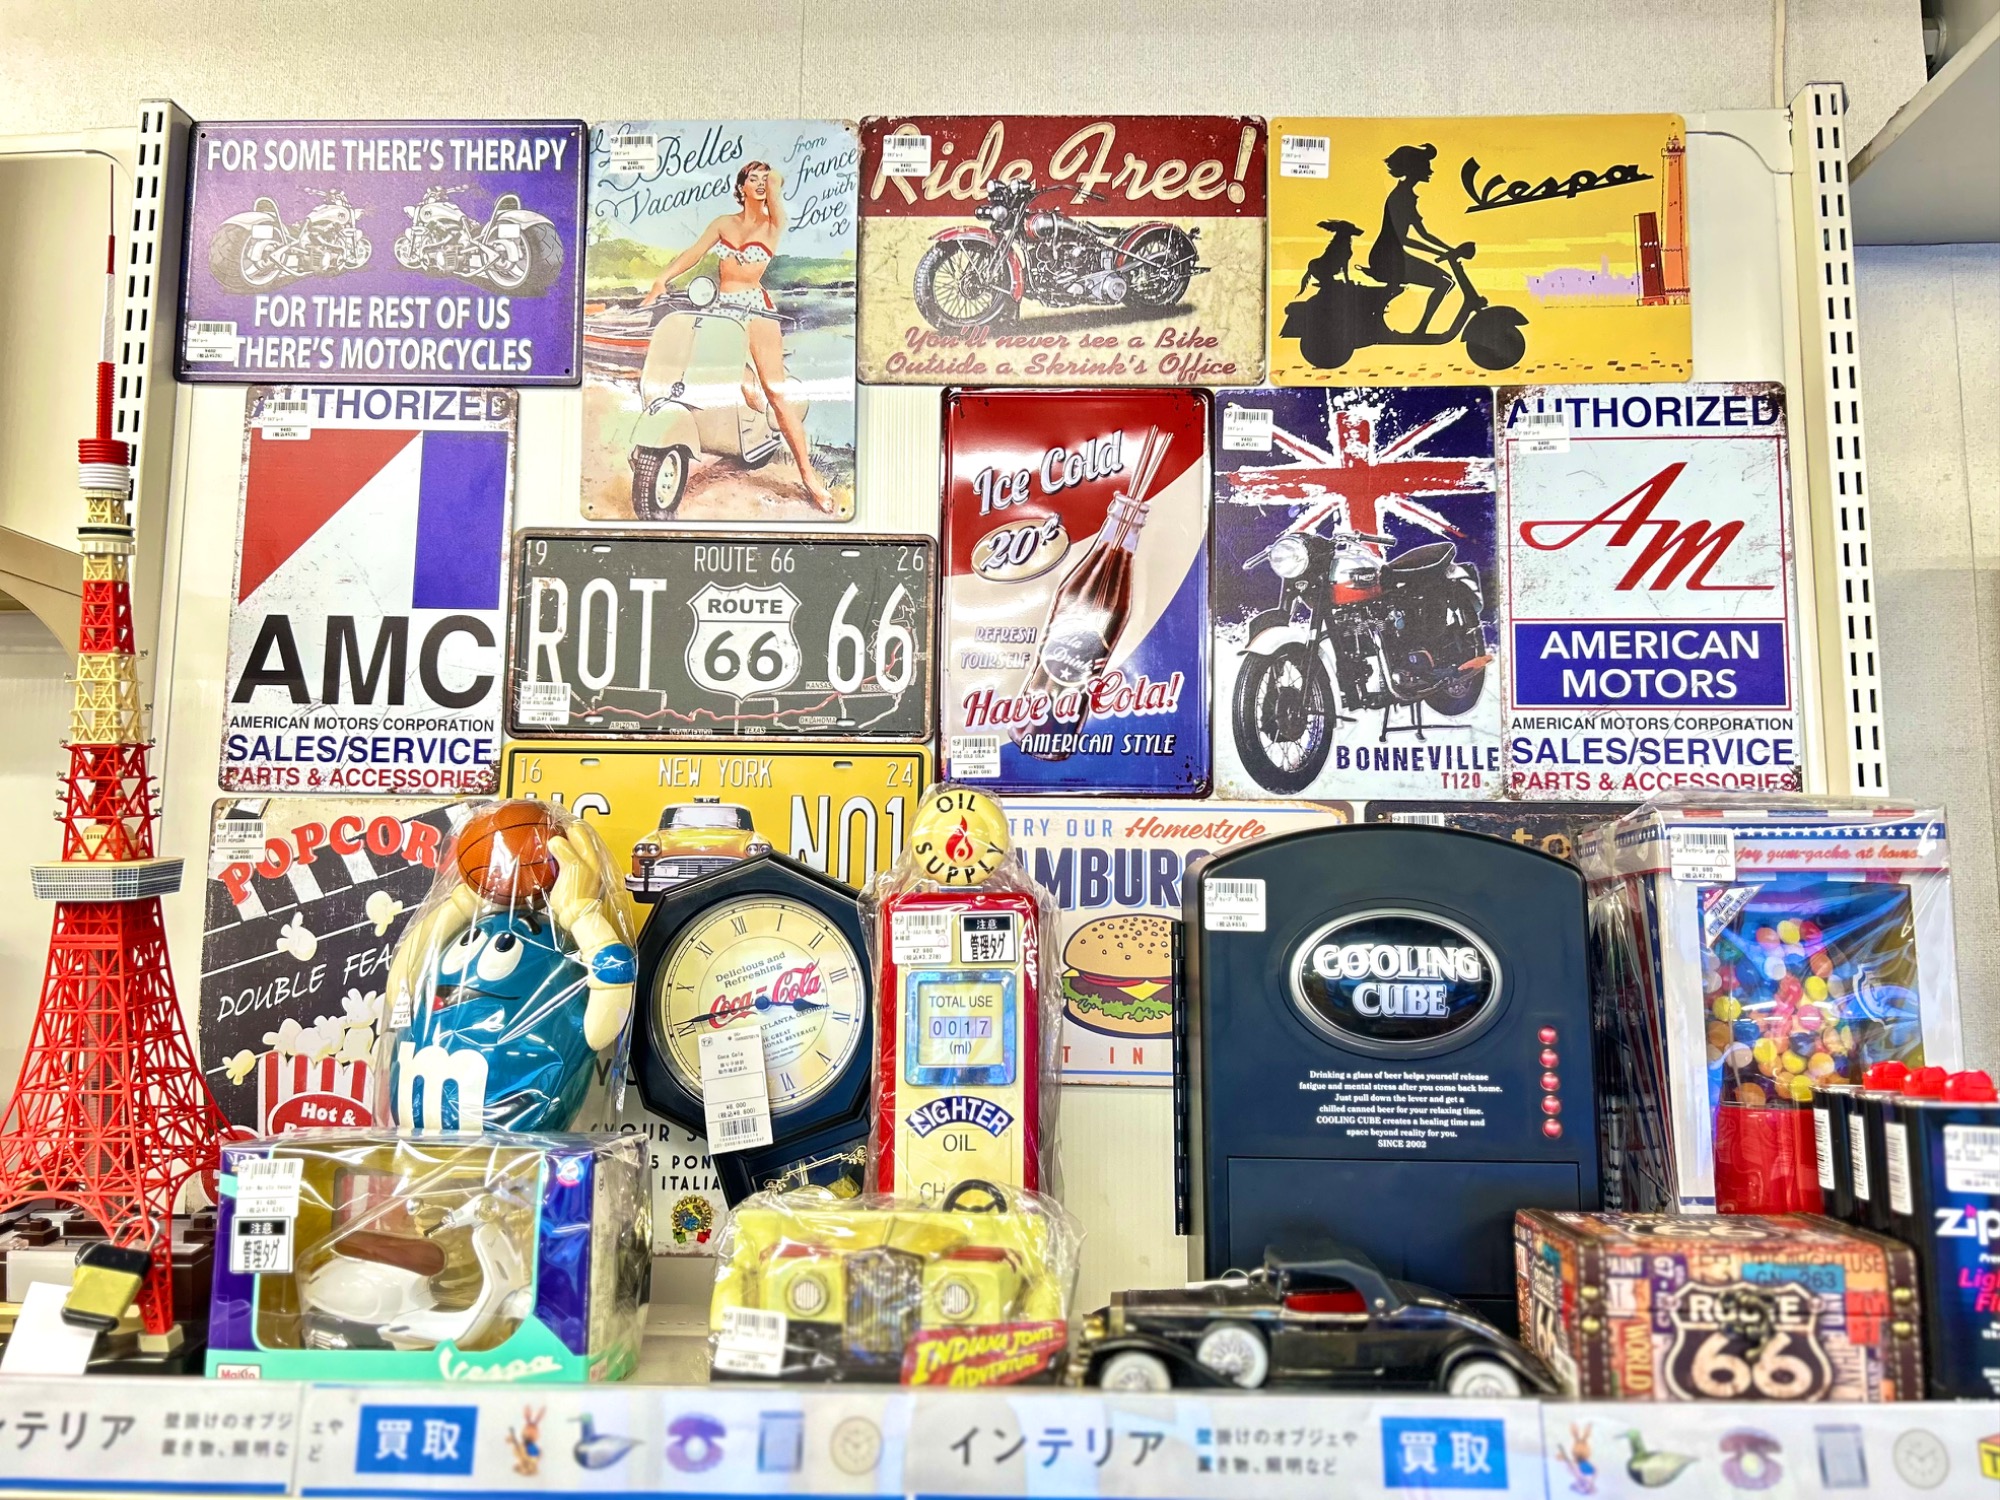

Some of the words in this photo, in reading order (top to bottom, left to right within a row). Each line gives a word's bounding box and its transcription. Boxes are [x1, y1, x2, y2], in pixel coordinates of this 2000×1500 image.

[207, 139, 257, 172] FOR
[263, 139, 335, 172] SOME
[342, 139, 443, 172] THERE'S
[450, 138, 567, 172] THERAPY
[645, 125, 743, 182] Belles
[784, 135, 828, 163] from
[1050, 122, 1257, 204] Free!
[784, 148, 857, 200] france
[822, 172, 857, 201] with
[1461, 157, 1654, 213] Vespa
[600, 174, 731, 224] Vacances
[788, 196, 847, 233] Love
[255, 296, 305, 328] FOR
[314, 297, 363, 328] THE
[369, 297, 430, 328] REST
[436, 298, 470, 329] OF
[477, 298, 510, 330] US
[904, 326, 989, 353] You'll
[997, 333, 1070, 350] never
[1080, 334, 1119, 350] see
[1125, 334, 1146, 349] a
[1155, 326, 1219, 350] Bike
[233, 337, 333, 369] THERE'S
[341, 338, 532, 371] MOTORCYCLES
[885, 352, 986, 377] Outside
[997, 359, 1015, 376] a
[1158, 352, 1236, 382] Office
[973, 466, 1030, 516] Ice
[1040, 430, 1124, 495] Cold
[526, 540, 548, 565] 19
[694, 545, 758, 573] ROUTE
[770, 547, 795, 573] 66
[897, 546, 925, 572] 26
[707, 598, 783, 615] ROUTE
[531, 577, 667, 691] ROT
[827, 581, 914, 695] 66
[974, 627, 1037, 644] REFRESH
[1540, 630, 1759, 660] AMERICAN
[231, 614, 496, 709] AMC
[704, 630, 785, 682] 66
[960, 652, 1031, 670] YOURSELF
[1562, 669, 1737, 699] MOTORS
[963, 688, 1050, 729] Have
[1054, 692, 1080, 718] a
[1088, 671, 1184, 714] Cola!
[230, 716, 309, 730] AMERICAN
[314, 717, 379, 731] MOTORS
[383, 718, 494, 732] CORPORATION
[1512, 717, 1595, 730] AMERICAN
[1600, 718, 1669, 731] MOTORS
[1674, 718, 1793, 731] CORPORATION
[228, 734, 493, 765] SALES/SERVICE
[1020, 733, 1113, 754] AMERICAN
[1121, 734, 1177, 755] STYLE
[1512, 737, 1794, 765] SALES/SERVICE
[519, 757, 543, 783] 16
[1336, 745, 1500, 772] BONNEVILLE
[224, 767, 299, 786] PARTS
[307, 768, 322, 786] &
[329, 768, 492, 789] ACCESSORIES
[658, 758, 702, 787] NEW
[719, 759, 775, 788] YORK
[887, 762, 913, 788] 24
[1441, 772, 1481, 790] T120
[1511, 772, 1590, 790] PARTS
[1599, 772, 1614, 790] &
[936, 793, 976, 813] OIL
[1009, 818, 1050, 837] TRY
[1066, 819, 1112, 837] OUR
[1125, 816, 1267, 845] Homestyle
[916, 841, 1004, 884] SUPPLY
[1855, 845, 1874, 860] at
[976, 918, 998, 930] 注意
[970, 933, 1006, 961] 管理タグ
[715, 961, 765, 983] Delicious
[766, 951, 786, 966] and
[724, 962, 783, 989] Refreshing
[1313, 944, 1482, 982] COOLING
[217, 963, 327, 1022] DOUBLE
[343, 943, 393, 985] FEA
[928, 995, 966, 1008] TOTAL
[969, 995, 993, 1008] USE
[1352, 982, 1450, 1018] CUBE
[771, 1029, 791, 1040] GREAT
[785, 1026, 818, 1041] BEVERAGE
[932, 1020, 989, 1036] 0017
[949, 1040, 972, 1055] (ml)
[1110, 1047, 1143, 1065] IN
[398, 1041, 489, 1135] m
[1299, 1081, 1326, 1091] fatigue
[1327, 1082, 1343, 1090] and
[1373, 1083, 1397, 1091] stress
[1398, 1083, 1417, 1091] after
[1457, 1084, 1477, 1092] back
[1334, 1093, 1352, 1102] Just
[1353, 1094, 1369, 1103] pull
[1370, 1094, 1392, 1102] down
[1393, 1094, 1406, 1102] the
[1408, 1094, 1428, 1102] lever
[1429, 1095, 1444, 1103] and
[1445, 1096, 1458, 1104] get
[301, 1102, 338, 1122] Hot
[342, 1110, 356, 1126] &
[910, 1098, 1009, 1136] LIGHTER
[943, 1134, 977, 1152] OIL
[1346, 1129, 1369, 1137] space
[1370, 1128, 1399, 1137] beyond
[1400, 1128, 1426, 1138] reality
[1427, 1129, 1440, 1137] for
[1377, 1139, 1404, 1148] SINCE
[1406, 1140, 1427, 1148] 2002
[662, 1176, 721, 1190] ITALIA
[251, 1222, 273, 1234] 注意
[1801, 1271, 1837, 1290] 263
[437, 1346, 563, 1380] Vespa
[911, 1337, 1007, 1385] INDIANA
[1009, 1326, 1056, 1355] JONES
[1625, 1323, 1651, 1390] WORLD
[1691, 1332, 1814, 1398] 66
[948, 1354, 1040, 1388] ADVENTURE
[0, 1411, 137, 1450] テリア
[375, 1418, 461, 1461] 買取
[949, 1426, 1165, 1468] インテリア
[1196, 1427, 1359, 1449] 壁掛けのオブジェや
[1399, 1431, 1492, 1475] 買取
